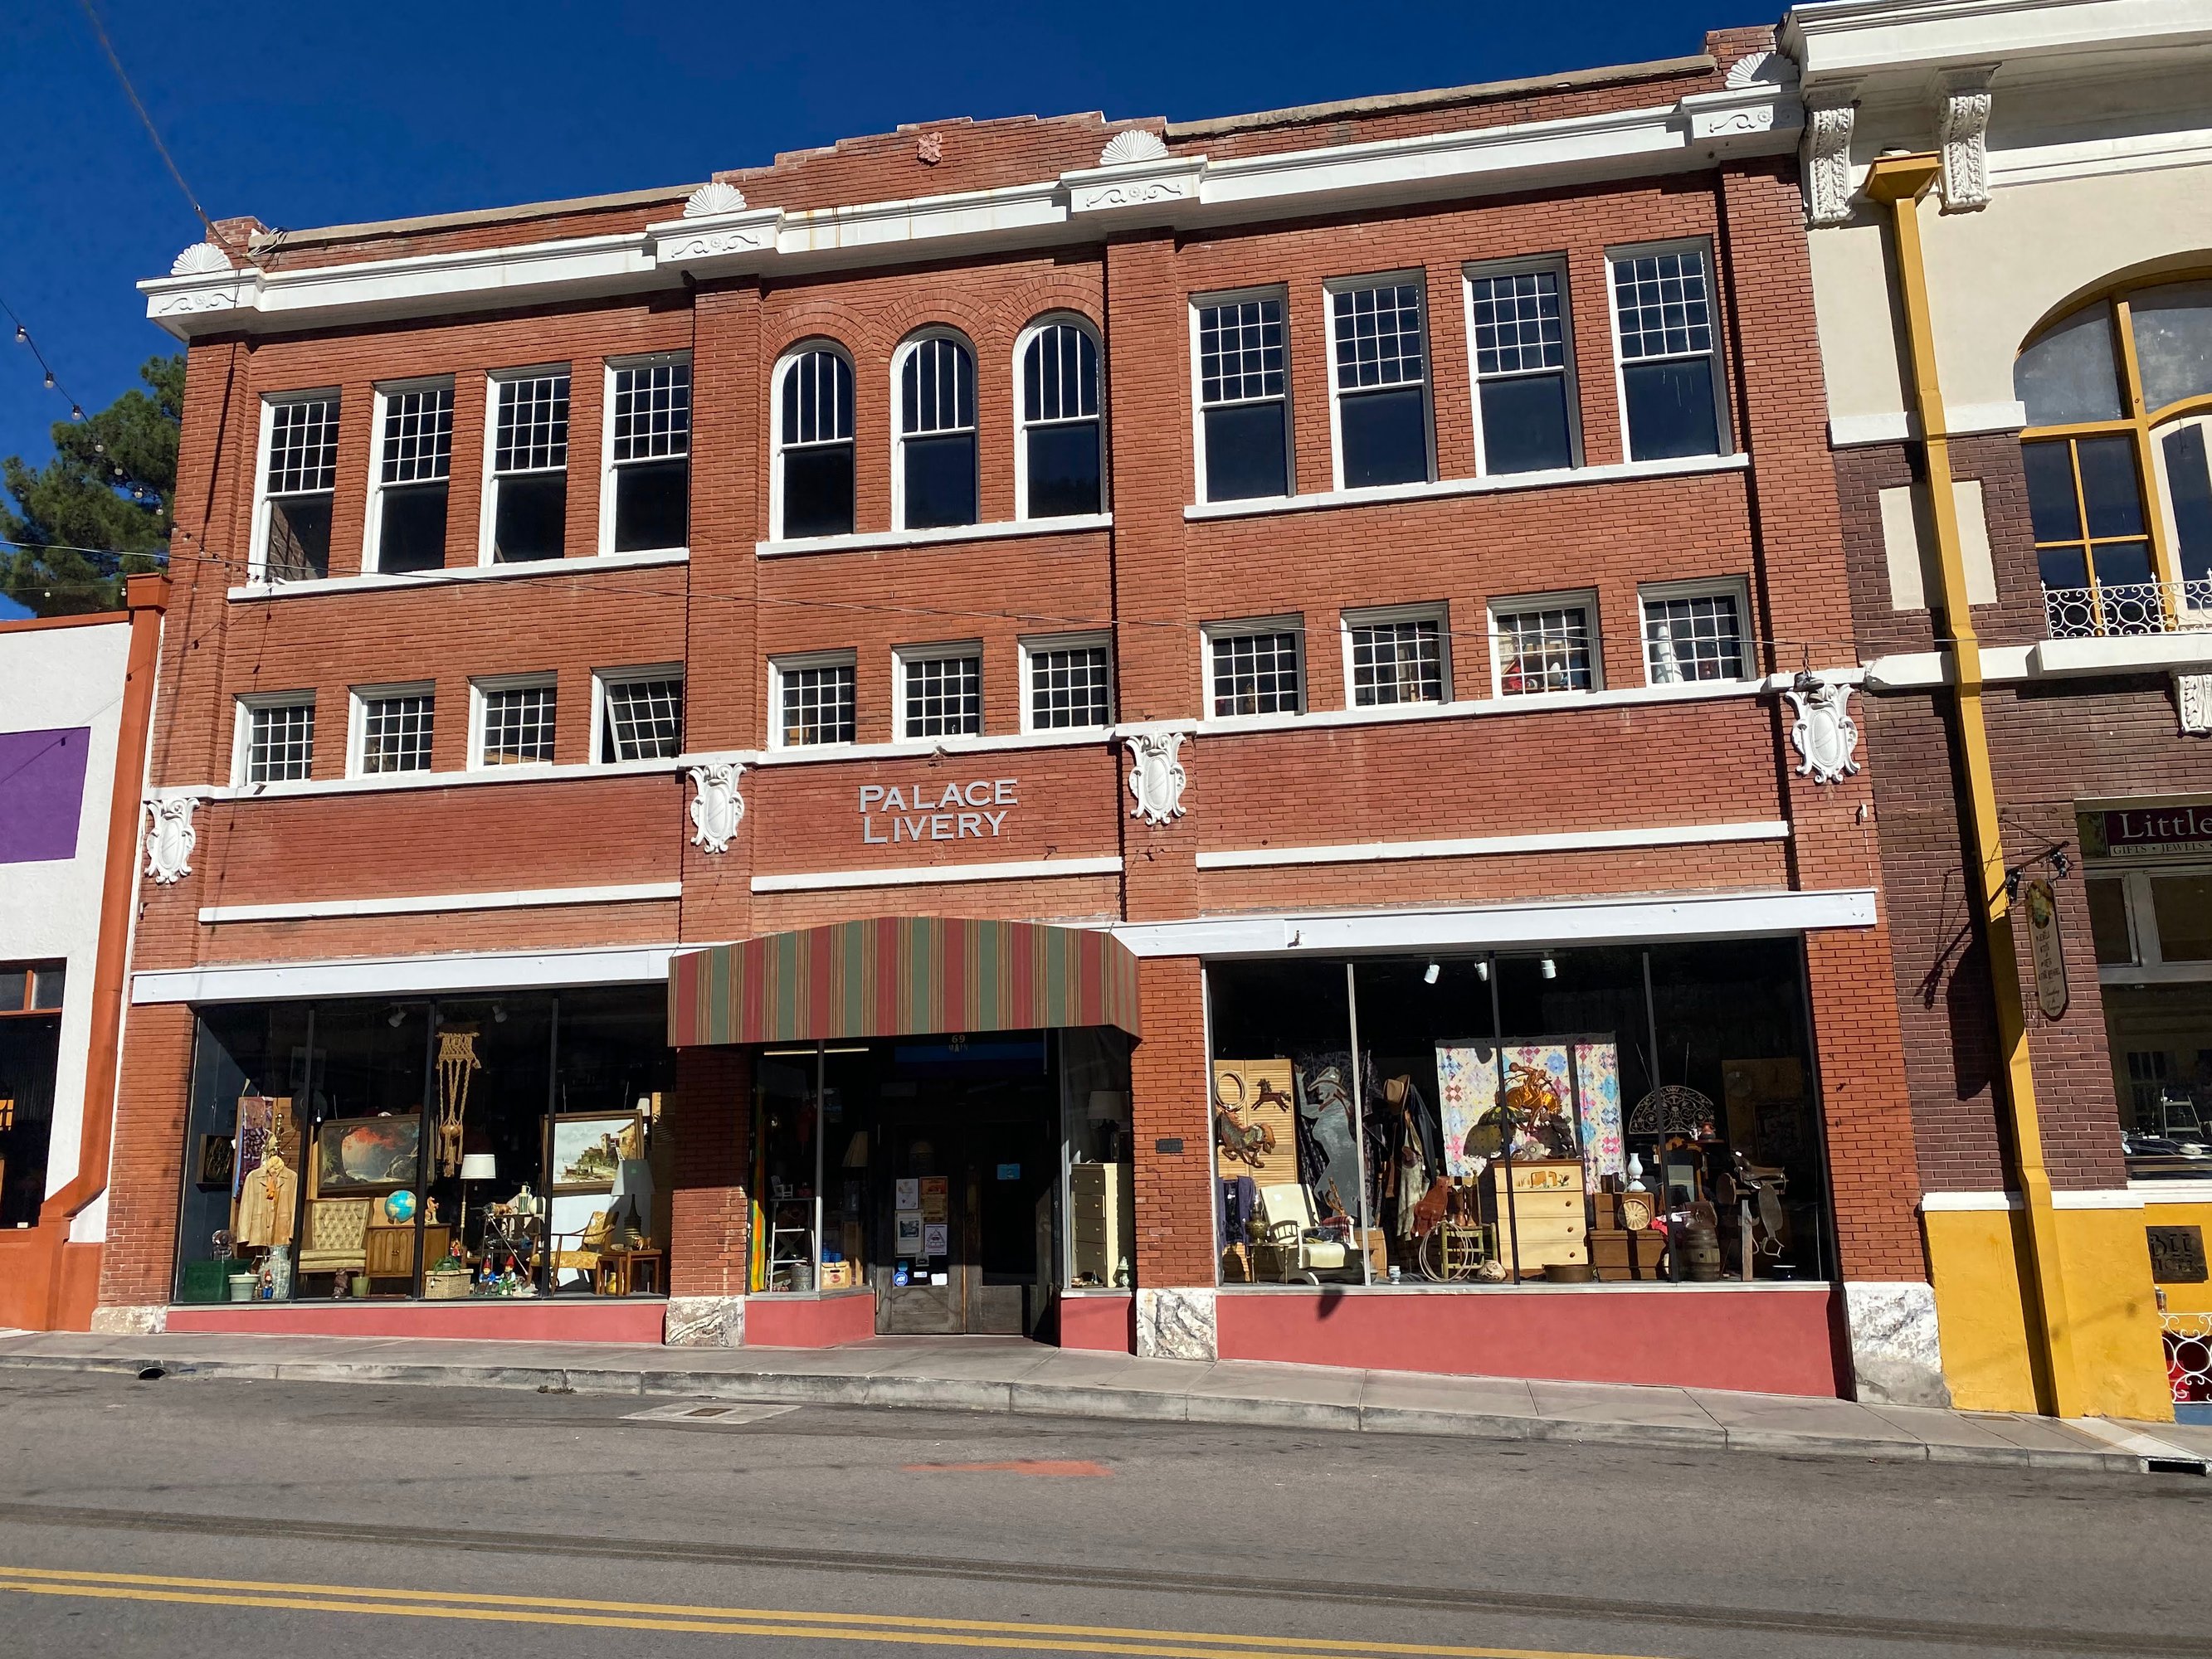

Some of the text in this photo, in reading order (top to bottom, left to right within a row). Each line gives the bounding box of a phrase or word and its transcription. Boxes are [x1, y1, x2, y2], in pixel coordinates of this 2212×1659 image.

[859, 778, 1018, 814] PALACE
[863, 810, 1009, 844] LIVERY
[2118, 809, 2212, 839] Little
[2113, 842, 2205, 855] GIFTS JEWELS
[952, 1034, 966, 1044] 69
